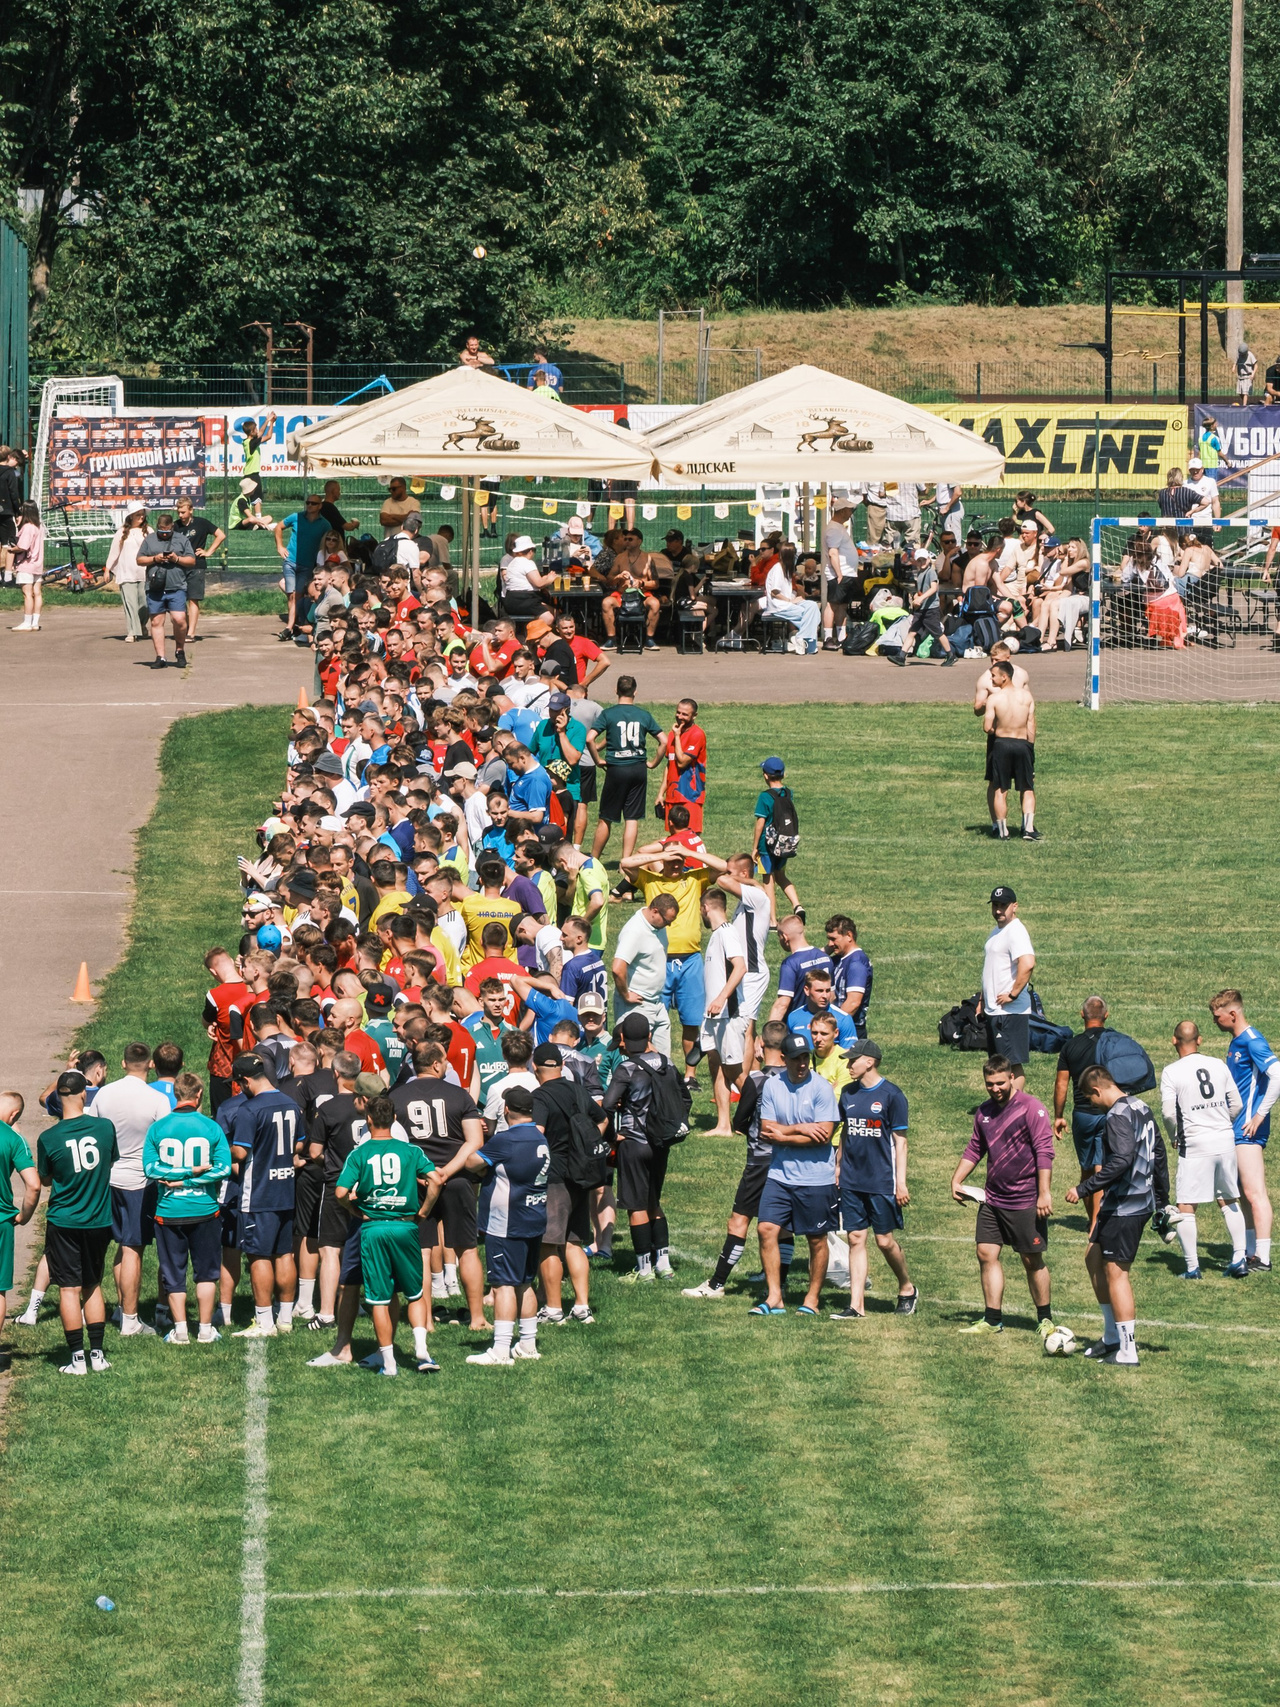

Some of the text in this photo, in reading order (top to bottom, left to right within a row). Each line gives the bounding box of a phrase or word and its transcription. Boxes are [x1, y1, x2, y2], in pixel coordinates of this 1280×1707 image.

[89, 447, 164, 473] ГРУППОВОЙ
[165, 445, 196, 464] ЭТАП
[686, 461, 737, 475] ЛІДСКАЕ
[616, 721, 640, 748] 14
[1196, 1068, 1215, 1100] 8
[271, 1109, 297, 1156] 11
[407, 1098, 449, 1140] 91
[65, 1135, 100, 1173] 16
[158, 1136, 210, 1168] 90
[366, 1152, 402, 1186] 19
